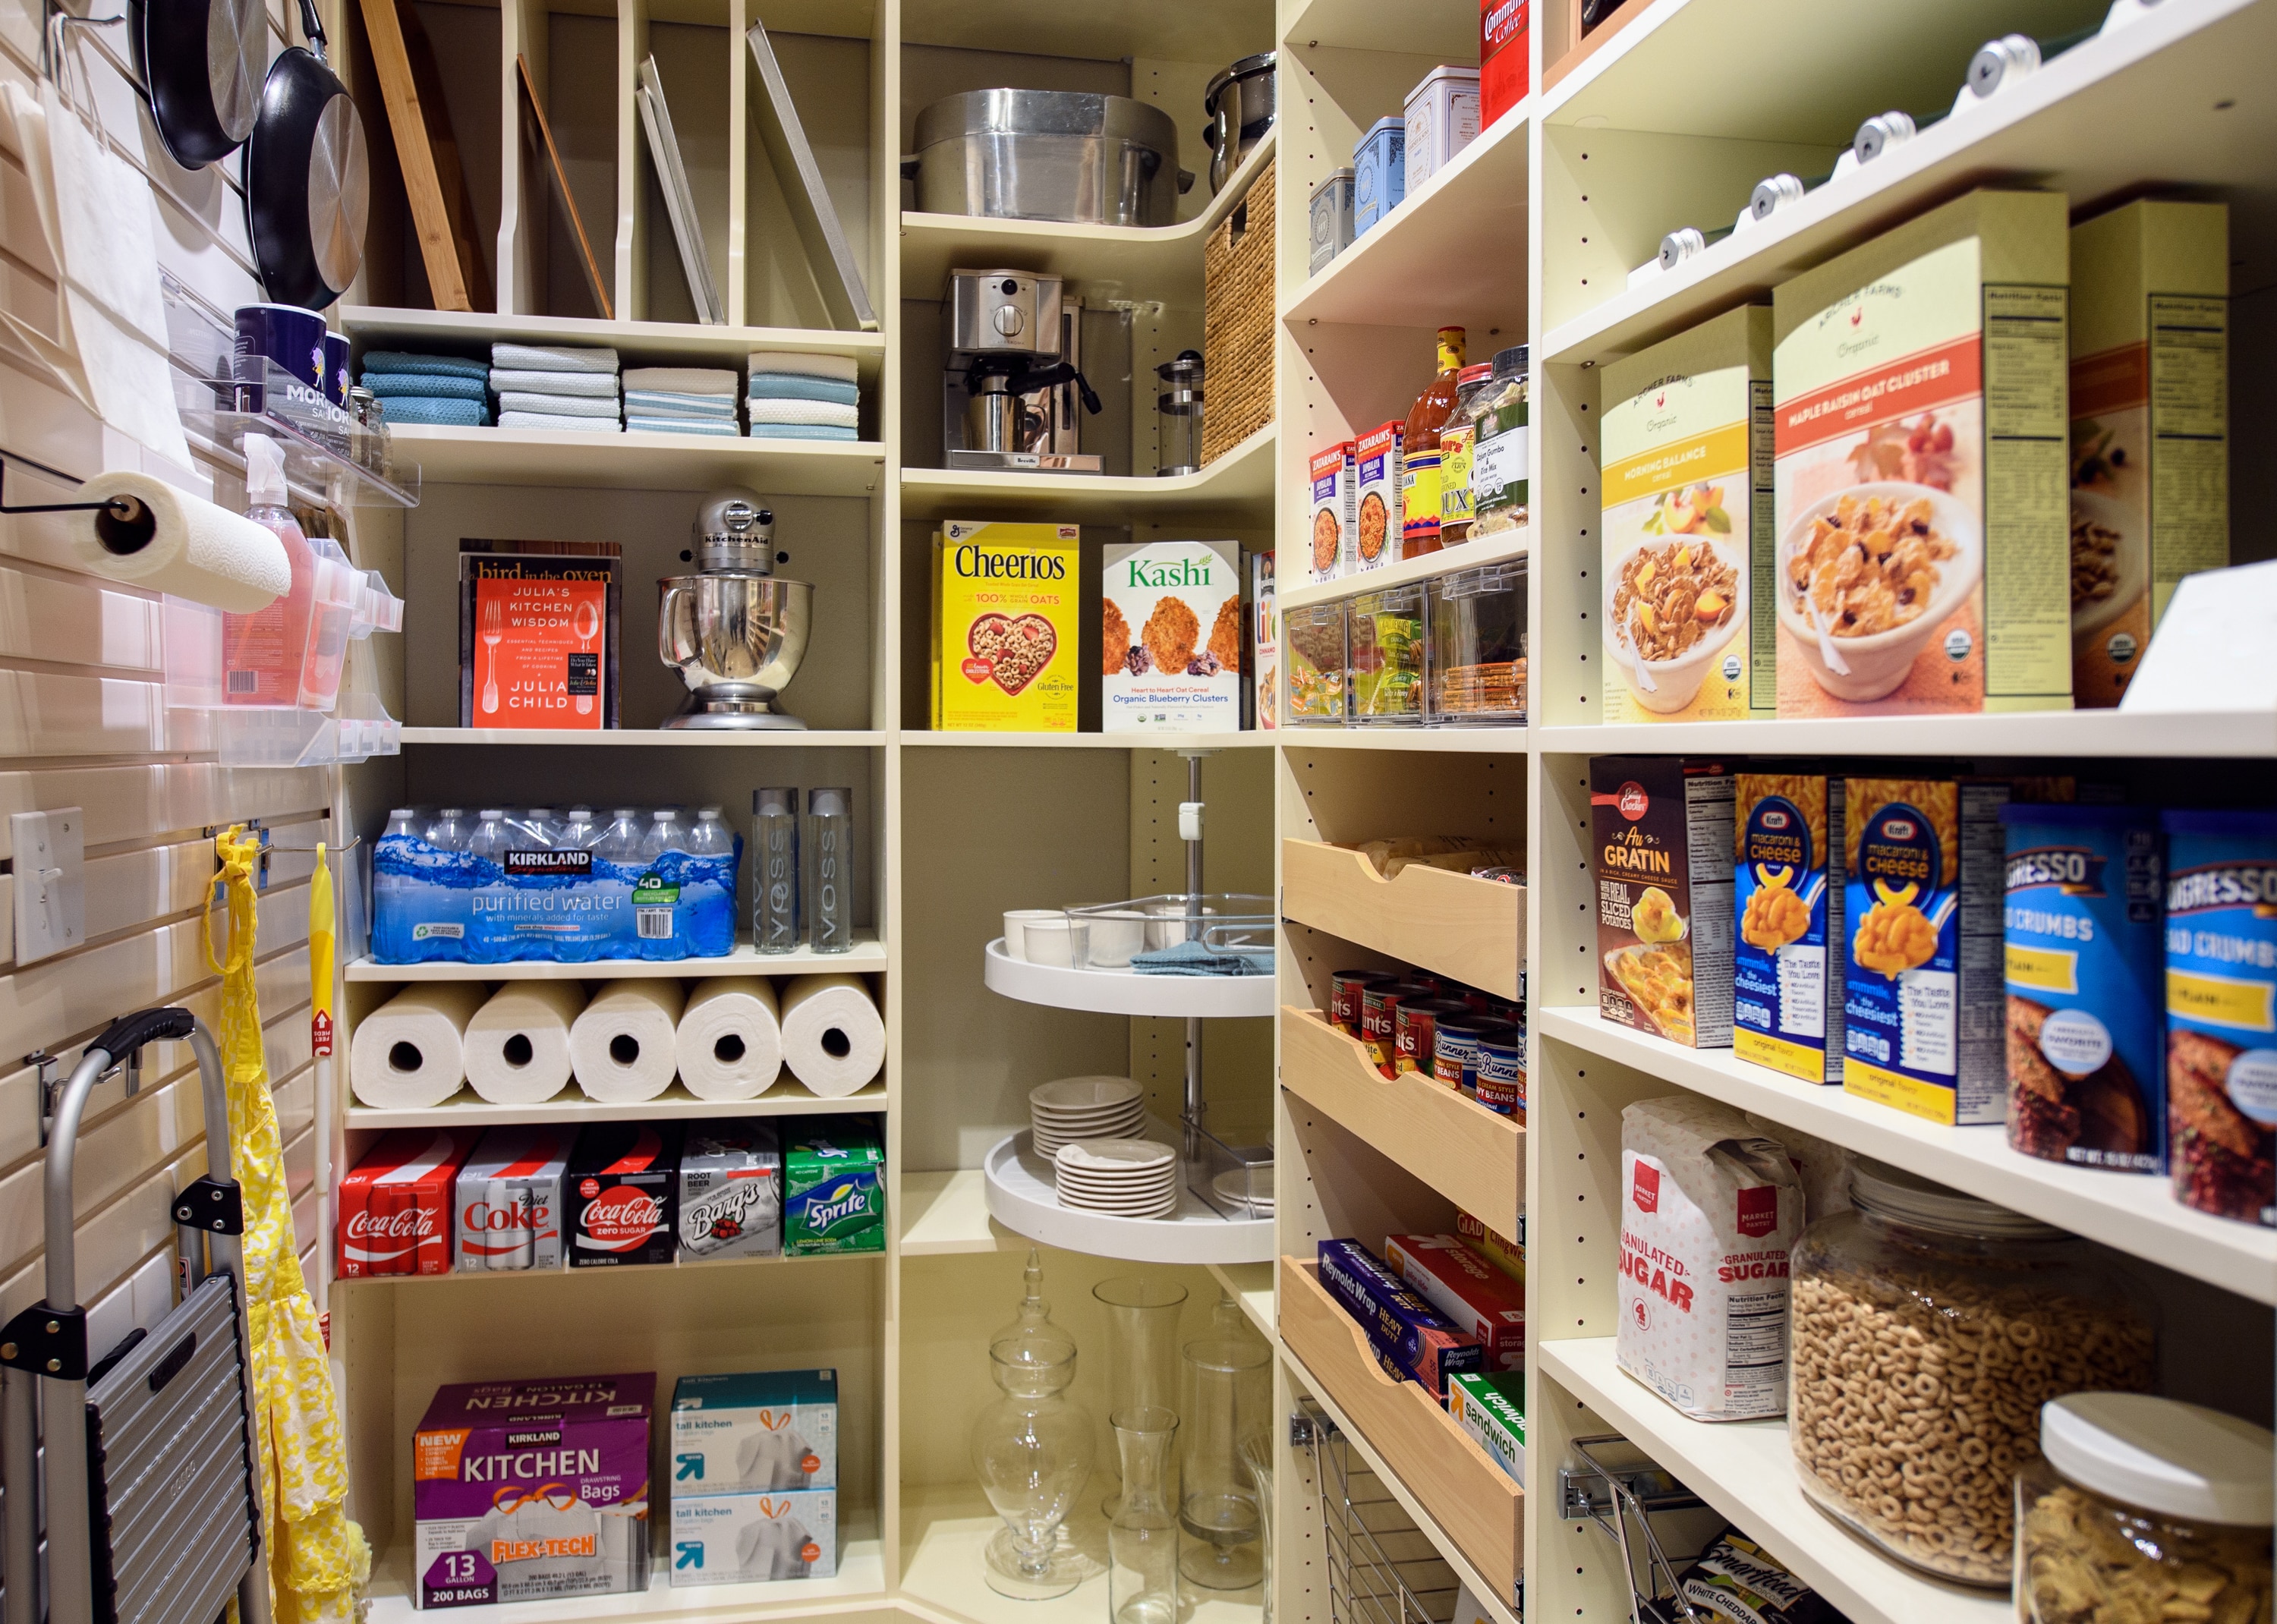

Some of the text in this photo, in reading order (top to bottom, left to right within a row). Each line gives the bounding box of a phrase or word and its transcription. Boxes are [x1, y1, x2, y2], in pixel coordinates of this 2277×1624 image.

[1495, 14, 1521, 44] Coffee
[1836, 334, 1879, 359] Organic
[1633, 374, 1693, 408] ARCHER FARMS
[1788, 360, 1950, 428] MAPLE RAISIN OAT CLUSTER
[1647, 414, 1677, 432] Organic
[1477, 445, 1504, 461] Cajun Gumbo
[1488, 464, 1497, 473] Mix
[1624, 445, 1707, 481] MORNING BALANCE
[1652, 469, 1672, 483] cereal
[705, 536, 769, 545] KitchenAid
[956, 545, 1066, 580] Cheerios
[478, 562, 613, 583] bird the oven
[1128, 559, 1212, 587] Kashi
[513, 587, 570, 597] JULIA'S
[976, 593, 1006, 603] 100%
[1030, 595, 1060, 604] OATS
[509, 603, 573, 612] KITCHEN
[512, 618, 568, 628] WISDOM
[510, 681, 567, 692] JULIA
[1038, 682, 1074, 691] Gluten Free
[509, 697, 568, 709] CHILD
[1113, 694, 1228, 704] Organic Blueberry Clusters
[1624, 787, 1642, 800] Betty
[1766, 814, 1783, 825] Kraft
[1625, 826, 1643, 847] Au
[1887, 823, 1909, 837] Kraft
[1751, 834, 1801, 847] macaroni &
[509, 851, 589, 867] KIRKLAND
[1605, 845, 1670, 873] GRATIN
[1867, 843, 1920, 861] macaroni
[639, 878, 661, 889] 40
[1622, 871, 1639, 880] CREAMY
[822, 830, 836, 939] VOSS
[1610, 882, 1630, 905] REAL
[473, 892, 622, 915] purified water
[1601, 900, 1631, 919] SLICED
[1601, 914, 1632, 930] POTATOES
[2015, 908, 2093, 942] CRUMBS
[1784, 959, 1821, 969] The Taste
[1746, 971, 1757, 980] the
[1787, 970, 1820, 980] You Love
[1735, 977, 1777, 996] cheesiest
[1907, 987, 1951, 998] The Taste
[1861, 996, 1873, 1008] the
[1929, 999, 1951, 1009] Love
[1845, 999, 1898, 1027] cheesiest
[1435, 1032, 1469, 1059] Runner
[1753, 1038, 1776, 1051] original
[1437, 1067, 1460, 1078] BEANS
[1485, 1091, 1515, 1103] BEANS
[518, 1194, 549, 1207] Diet
[1635, 1184, 1655, 1201] MARKET
[464, 1201, 550, 1232] Coke
[580, 1196, 668, 1227] Coca-Cola
[688, 1184, 760, 1241] Barq's
[808, 1190, 865, 1229] Sprite
[1741, 1211, 1775, 1223] MARKET
[347, 1207, 439, 1239] Coca-Cola
[1457, 1213, 1483, 1237] GLAD
[465, 1258, 477, 1269] 12
[1445, 1248, 1490, 1281] storage
[1724, 1250, 1785, 1265] GRANULATED
[347, 1264, 359, 1274] 12
[1718, 1261, 1790, 1283] SUGAR
[1322, 1252, 1377, 1316] Reynolds Wrap
[1729, 1295, 1765, 1303] Nutrition
[1636, 1304, 1646, 1320] 4
[1379, 1307, 1403, 1336] HEAVY
[1381, 1323, 1399, 1344] DUTY
[1408, 1341, 1417, 1352] USA
[1447, 1348, 1479, 1360] Reynolds
[1445, 1357, 1465, 1367] Wrap
[466, 1390, 616, 1410] KITCHEN
[676, 1420, 732, 1430] tall kitchen
[1466, 1402, 1516, 1464] sandwich
[420, 1434, 461, 1446] NEW
[509, 1432, 560, 1443] KIRKLAND
[465, 1449, 600, 1482] KITCHEN
[581, 1475, 621, 1484] DRAWSTRING
[581, 1484, 620, 1501] Bags
[676, 1508, 732, 1518] tall kitchen
[493, 1533, 597, 1563] FLEX-TECH
[445, 1554, 475, 1578] 13
[1710, 1544, 1812, 1602] Smartfood
[446, 1575, 475, 1584] GALLON
[433, 1588, 489, 1602] 200 BAGS
[1687, 1583, 1716, 1600] WHITE
[1752, 1585, 1786, 1608] POPCORN
